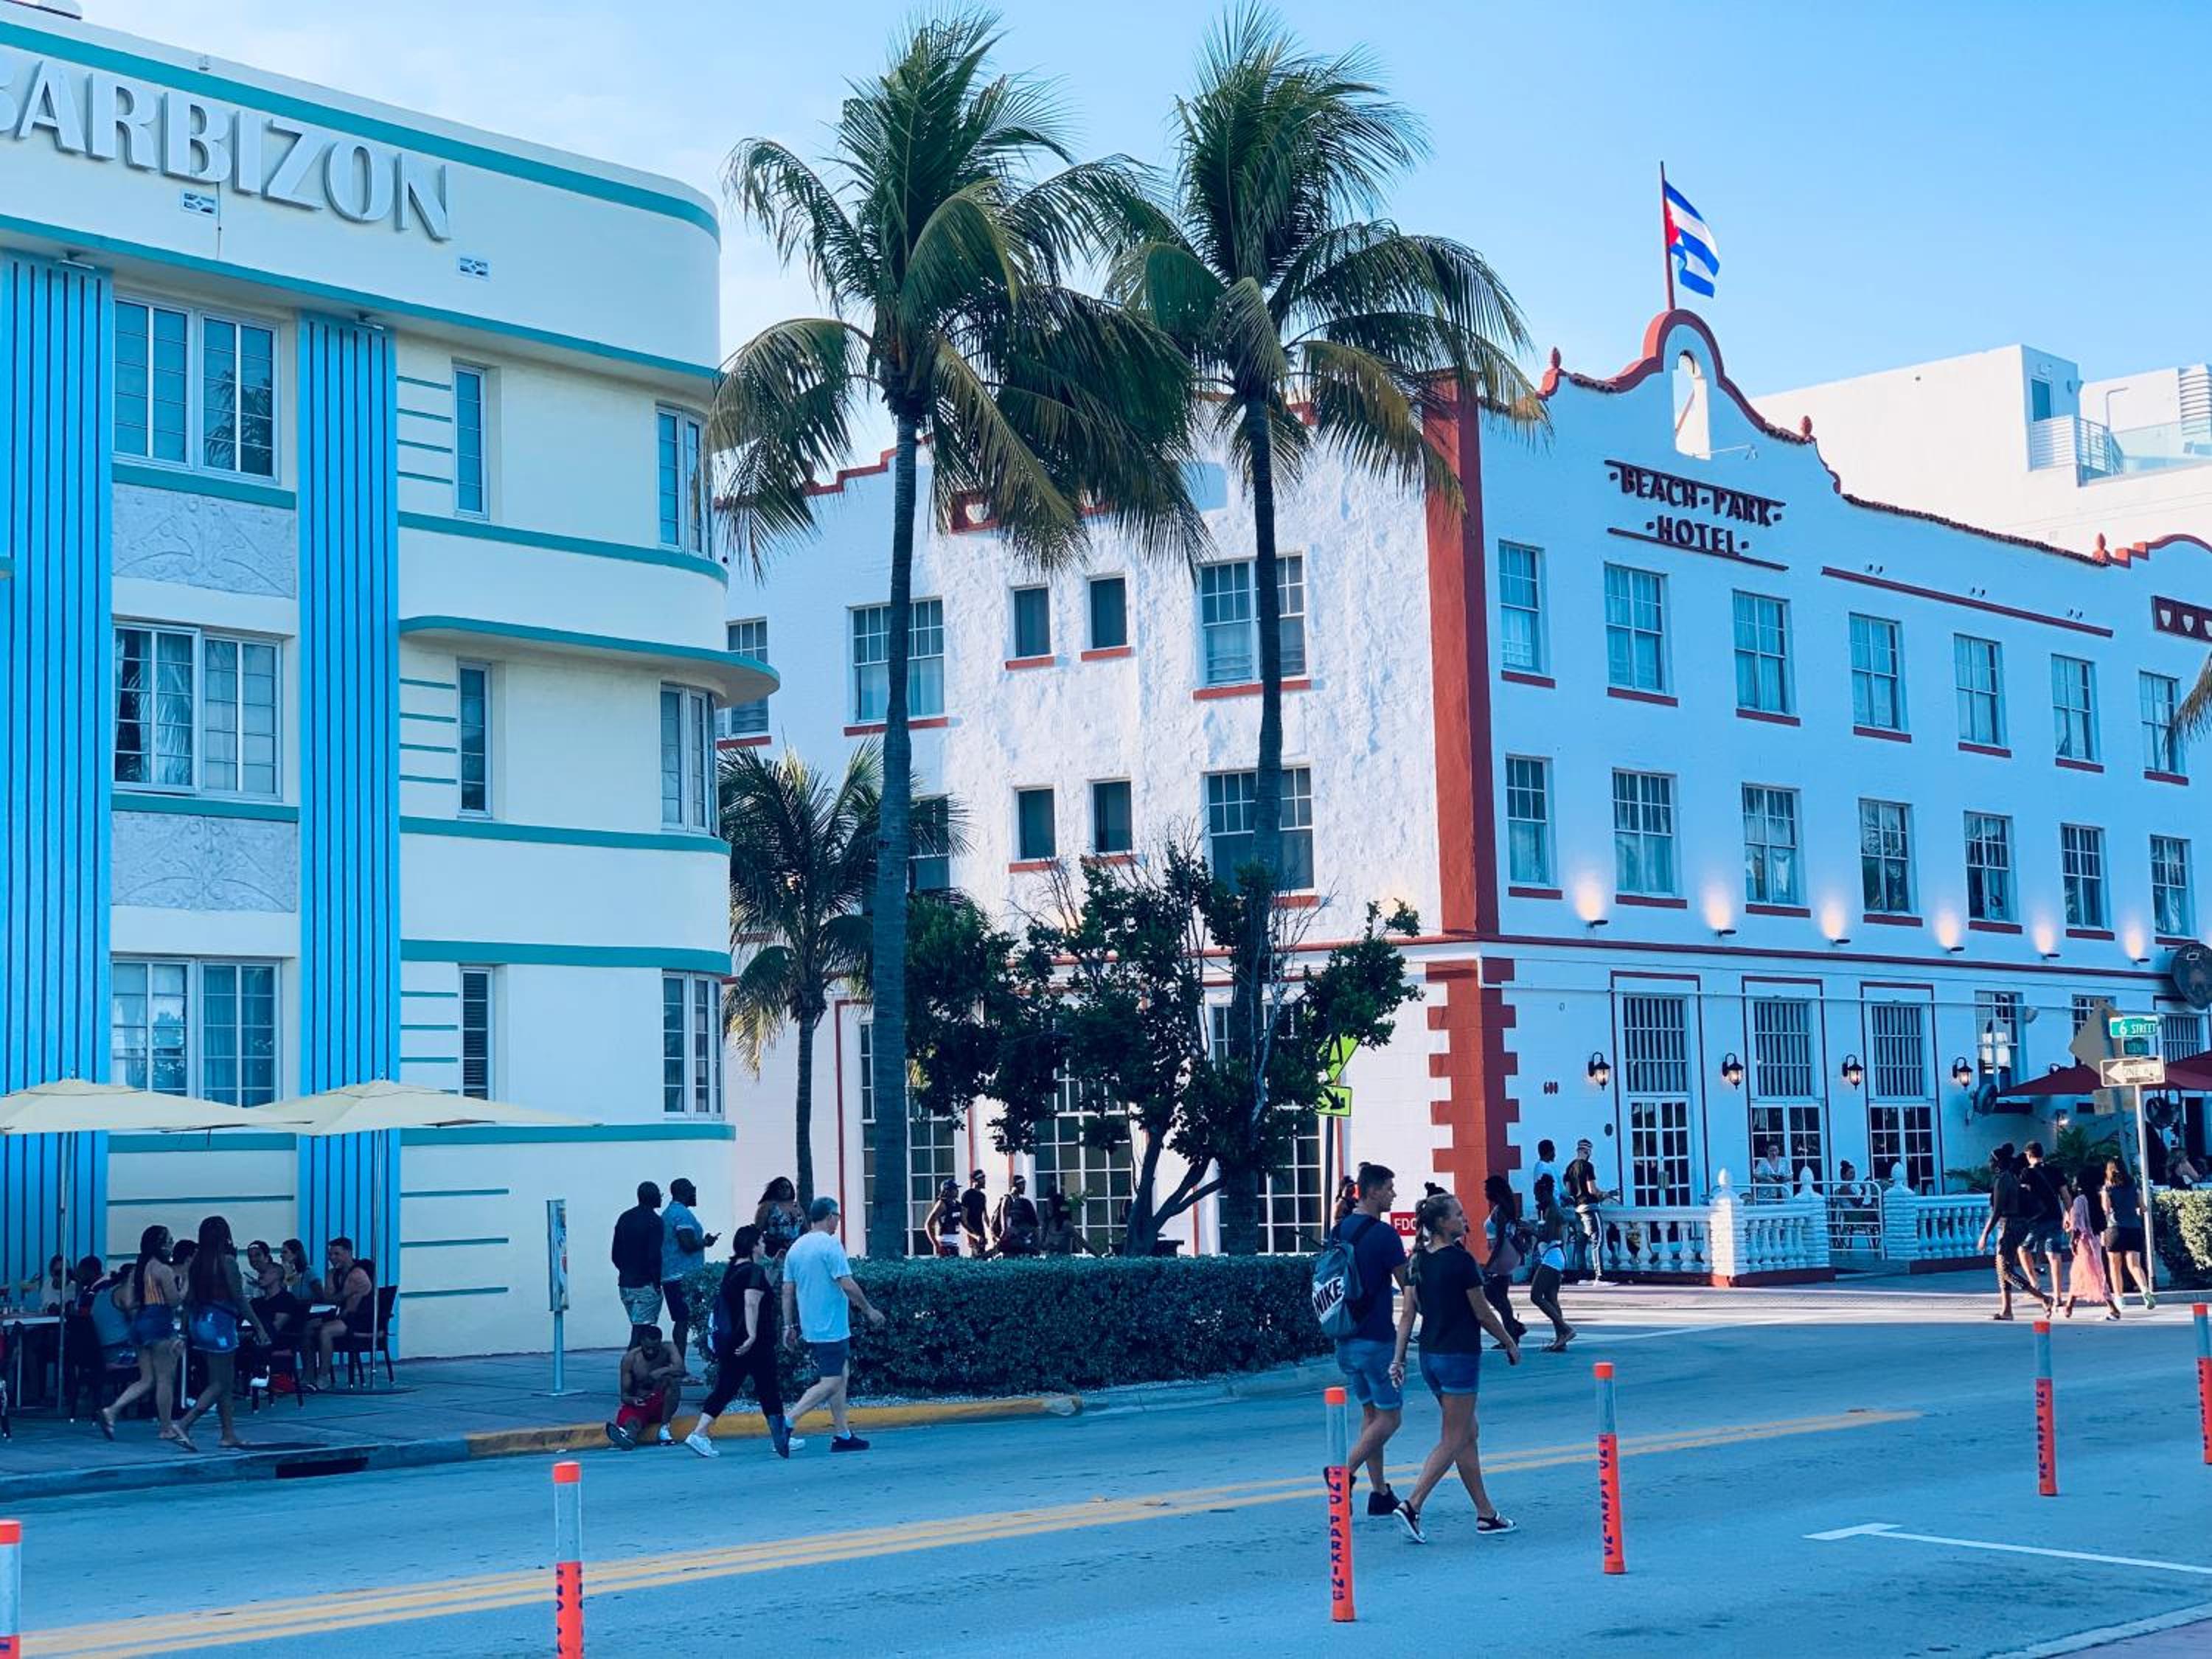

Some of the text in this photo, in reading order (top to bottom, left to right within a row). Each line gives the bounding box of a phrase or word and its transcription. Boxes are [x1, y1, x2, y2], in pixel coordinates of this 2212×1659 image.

[0, 58, 452, 243] ARBIZON
[1620, 465, 1773, 527] BEACH PARK
[1657, 515, 1740, 556] HOTEL
[2119, 1021, 2156, 1036] 6 STREET
[1313, 1278, 1343, 1315] NIKE
[1330, 1514, 1345, 1601] PARKING
